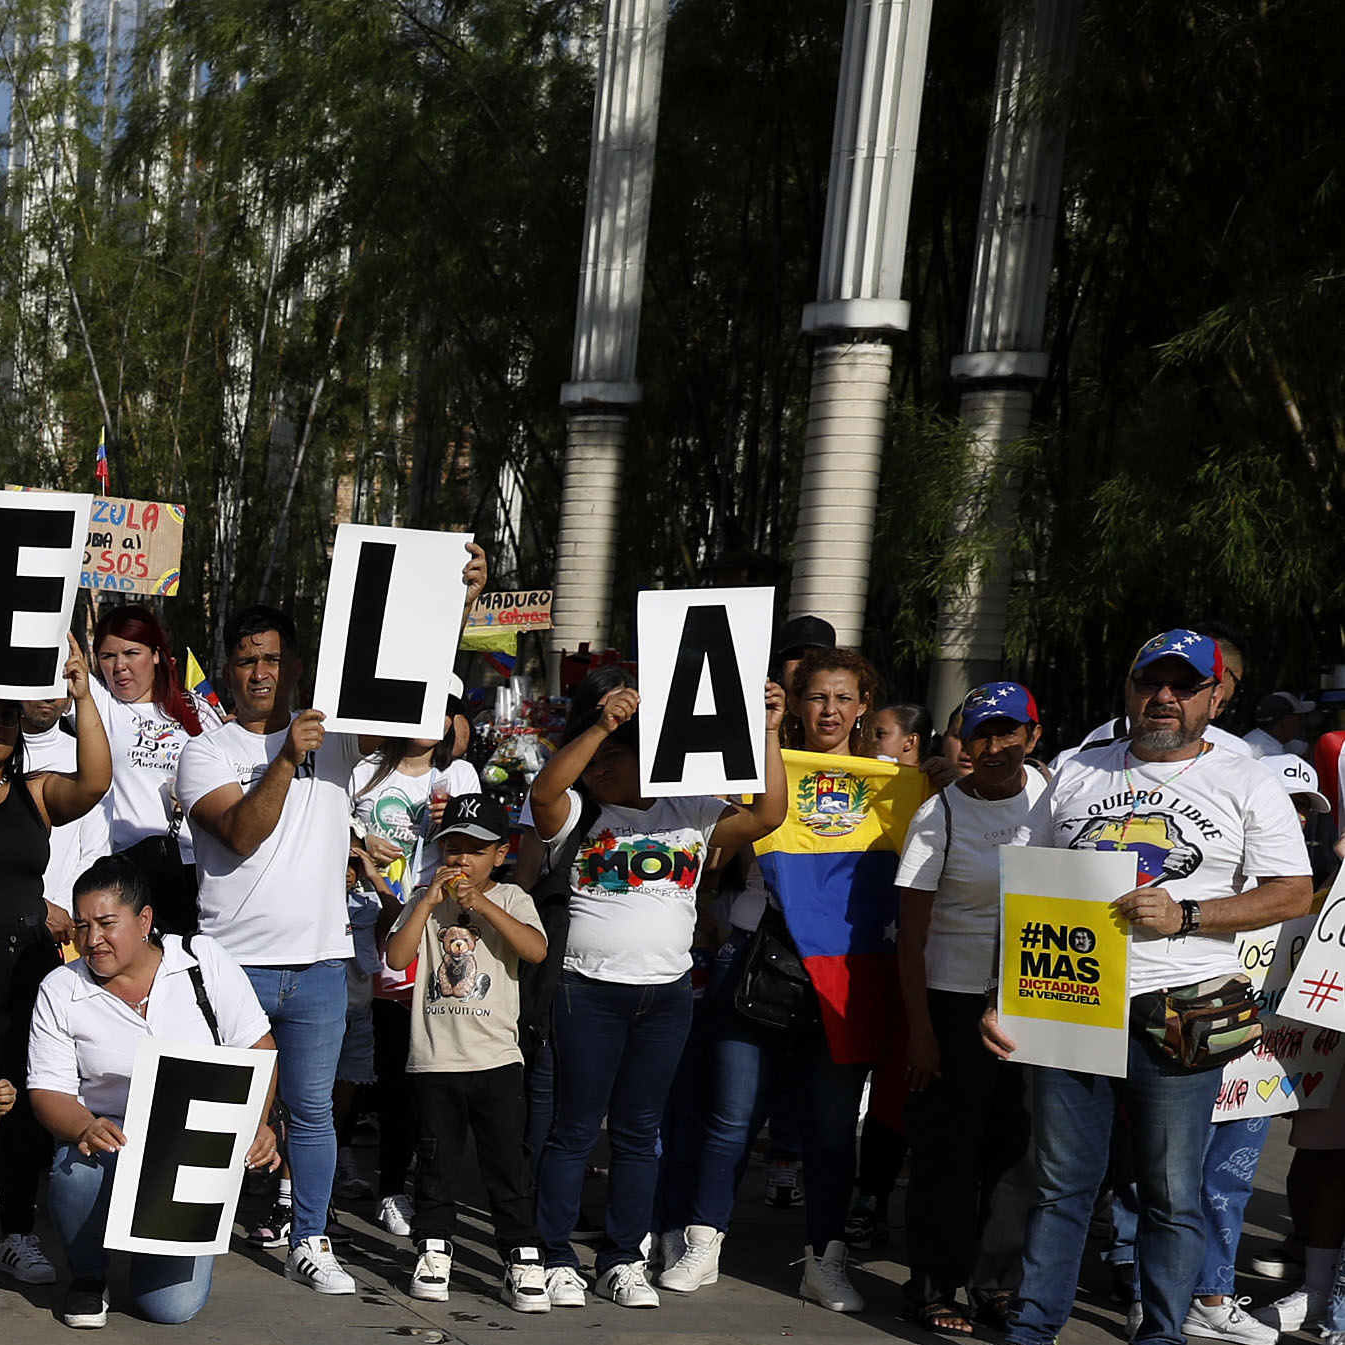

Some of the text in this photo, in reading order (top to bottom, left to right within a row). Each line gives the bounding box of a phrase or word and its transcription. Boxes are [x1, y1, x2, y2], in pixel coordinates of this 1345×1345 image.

[475, 591, 551, 611] MADURO
[337, 542, 427, 724] L
[650, 605, 757, 783] A
[457, 798, 481, 818] NY
[1087, 791, 1163, 816] QUIERO
[1168, 798, 1223, 842] LIBRE
[589, 850, 700, 884] MOM
[1020, 922, 1096, 954] #NO
[1020, 951, 1100, 984] MAS
[1019, 978, 1100, 997] DICTADURA
[1019, 989, 1101, 1006] EN VENEZUELA
[425, 1006, 446, 1015] OUIS
[130, 1056, 254, 1242] E
